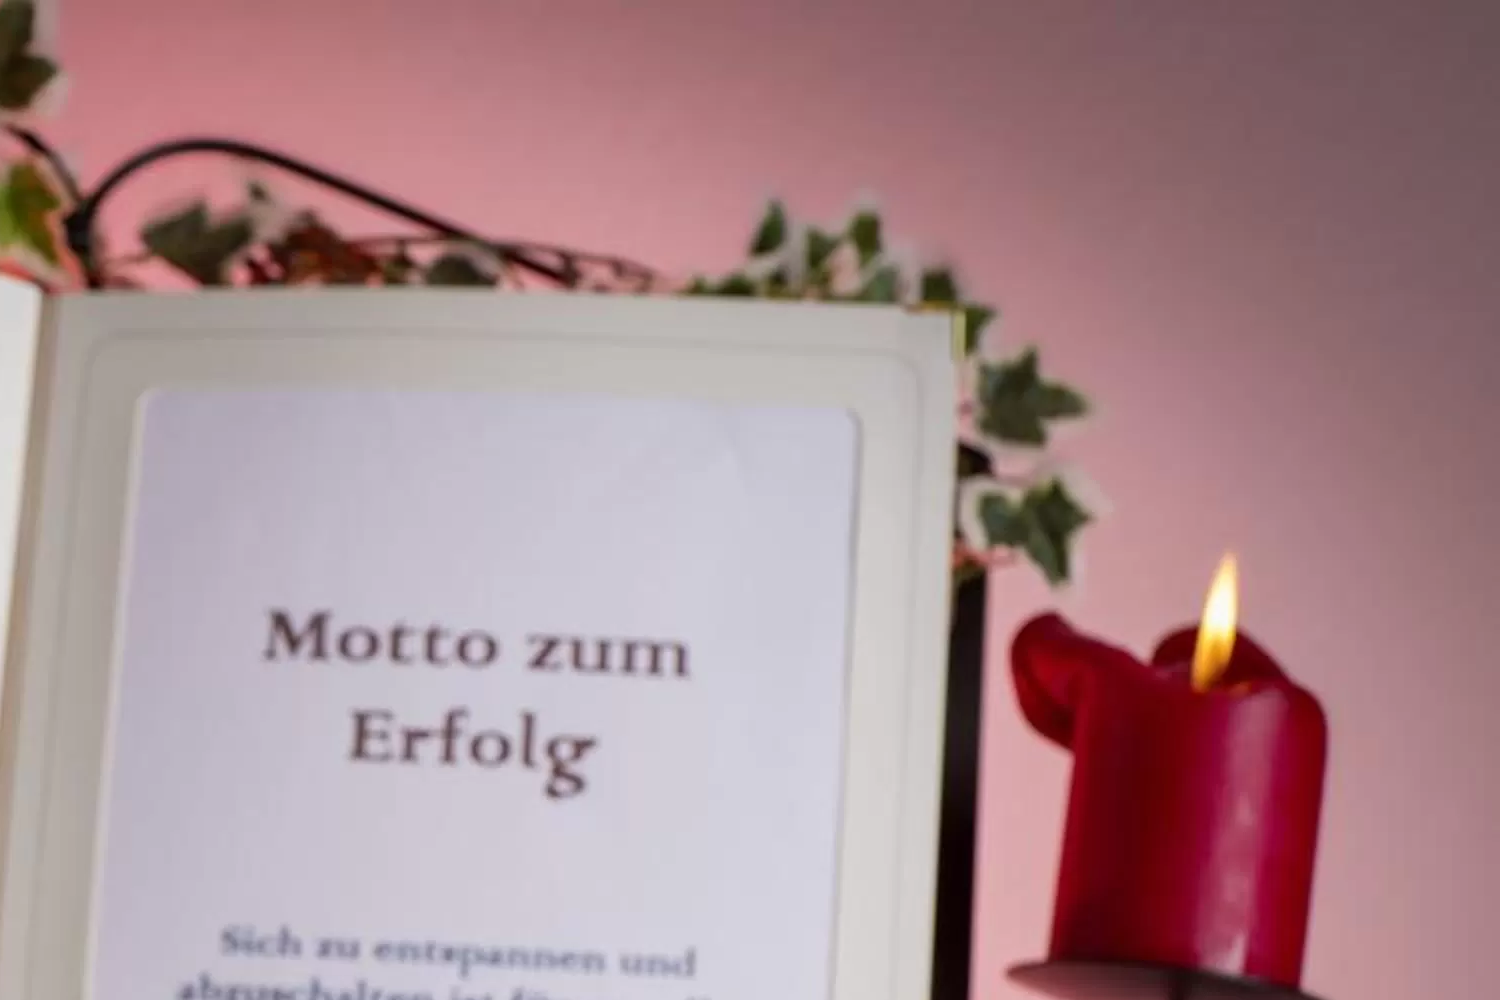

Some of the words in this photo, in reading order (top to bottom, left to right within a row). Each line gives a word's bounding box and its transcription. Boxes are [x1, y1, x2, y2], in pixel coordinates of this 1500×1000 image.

[263, 608, 497, 668] Motto
[525, 632, 692, 679] zum
[349, 707, 597, 800] Erfolg
[220, 925, 303, 958] Sich
[317, 938, 360, 960] zu
[374, 939, 606, 979] entspannen
[620, 947, 697, 977] und
